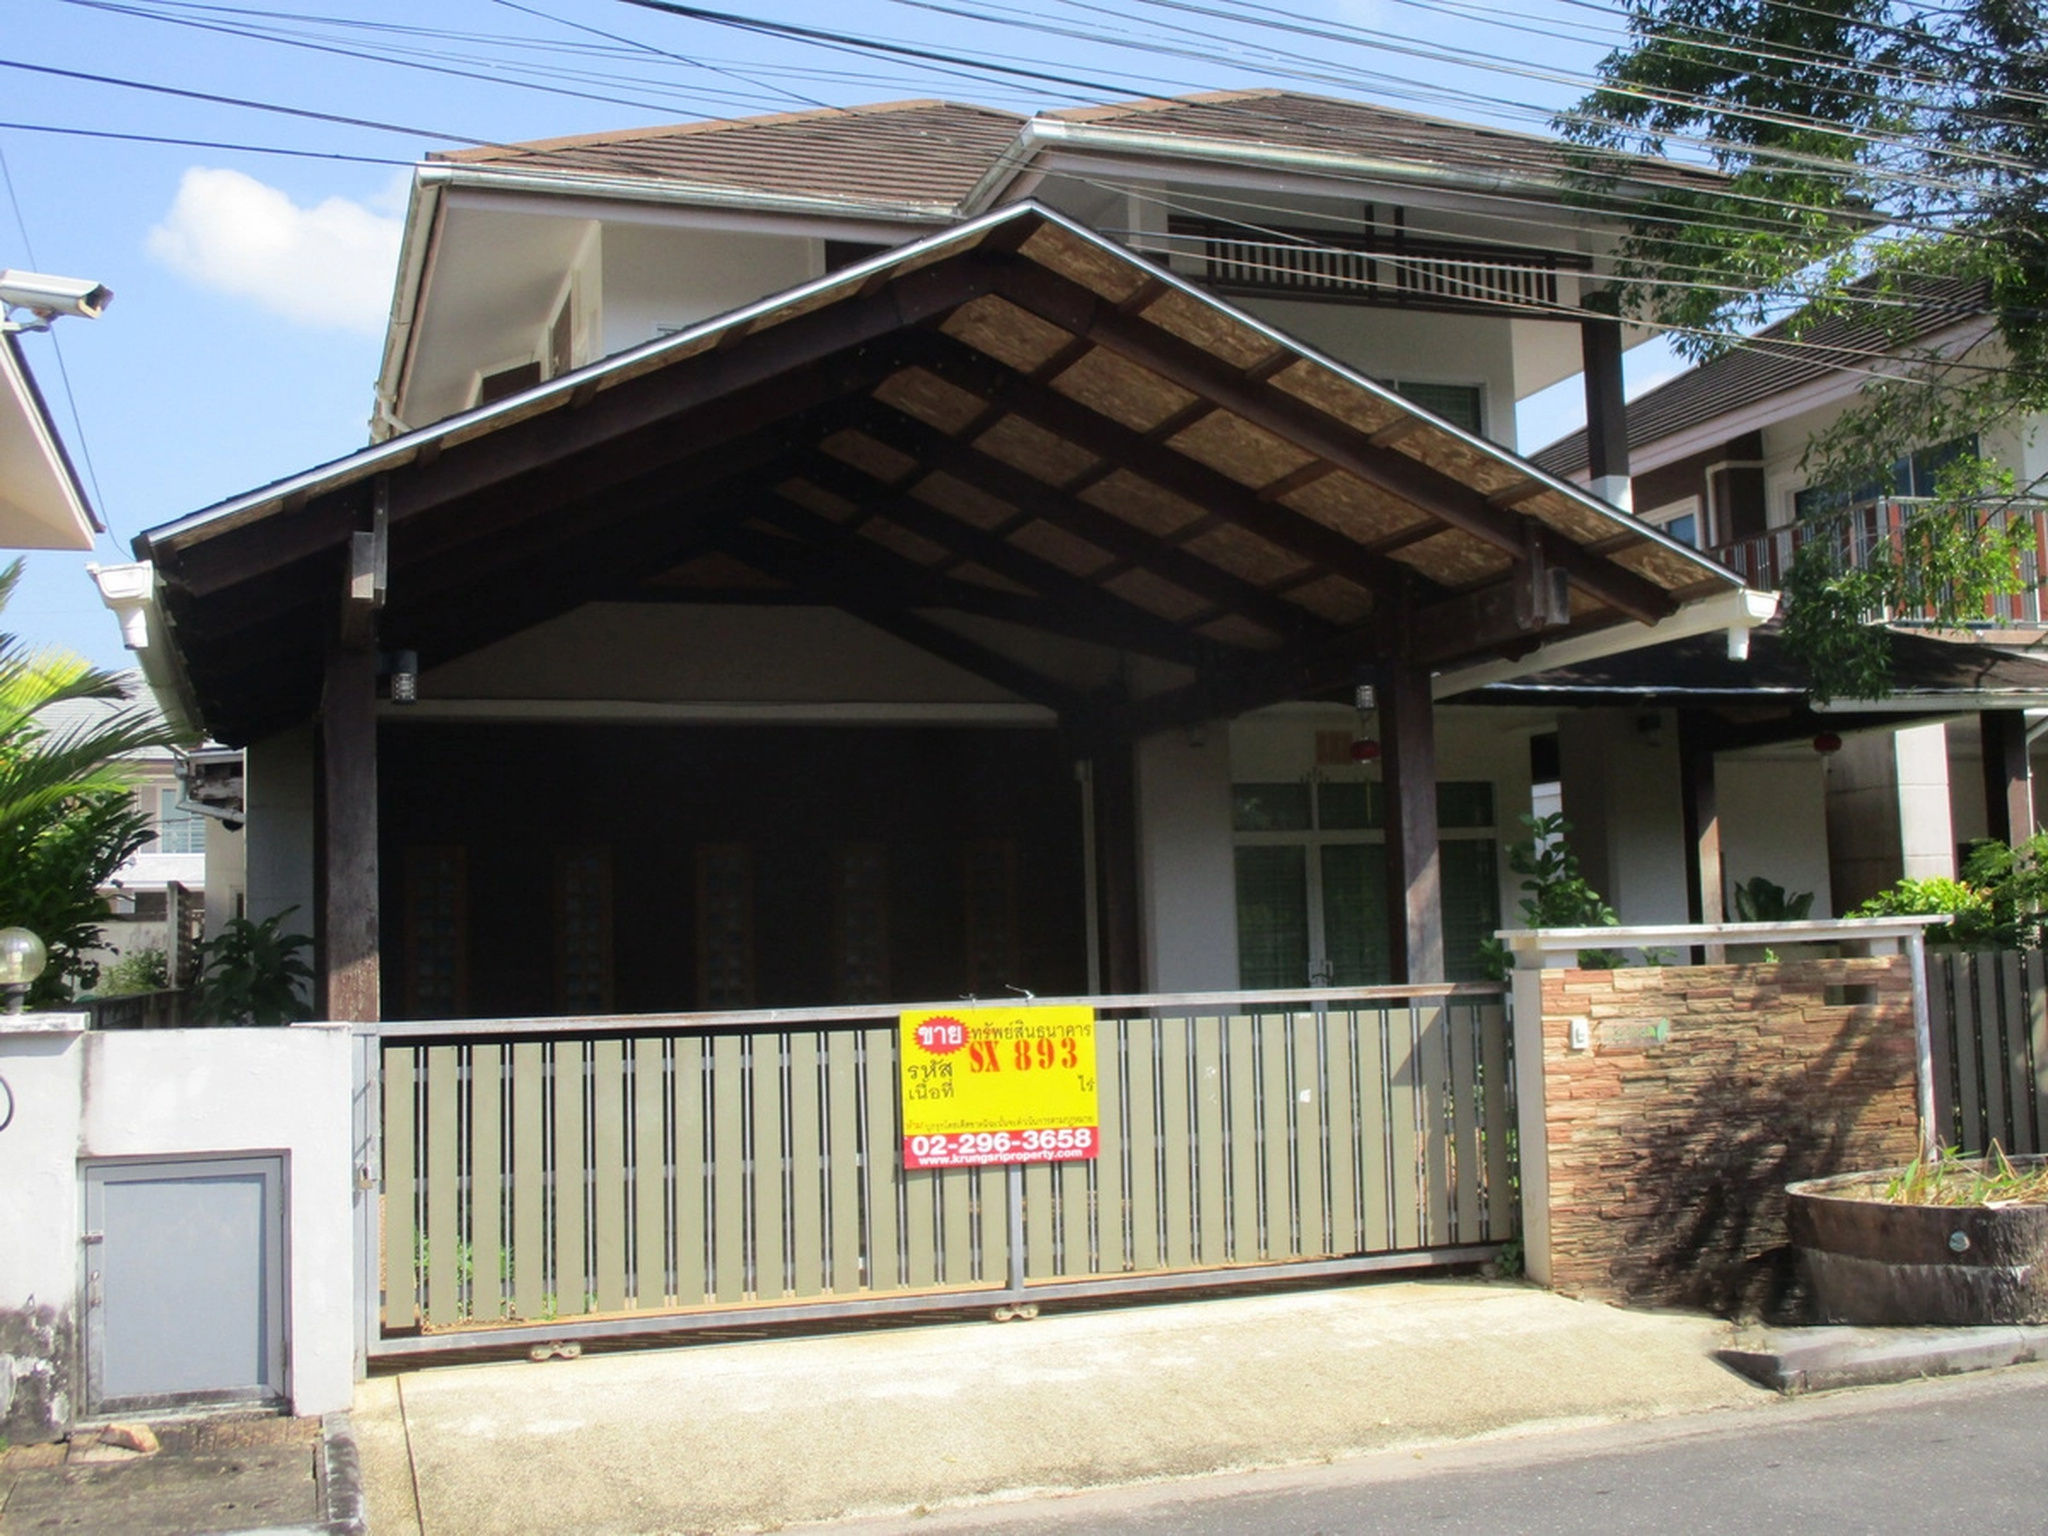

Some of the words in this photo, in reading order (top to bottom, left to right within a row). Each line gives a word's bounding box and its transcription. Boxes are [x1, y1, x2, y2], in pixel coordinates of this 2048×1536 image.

[918, 1025, 962, 1045] ขาย
[971, 1020, 1091, 1040] ทรัพย์สินธนาคาร
[969, 1040, 1000, 1073] SX
[1014, 1037, 1078, 1071] 893
[908, 1059, 953, 1080] รหัส
[909, 1078, 955, 1100] เนื้อที่
[1077, 1074, 1095, 1092] ไร่
[911, 1128, 1092, 1157] 02-296-3658
[918, 1149, 1083, 1166] www.krungsriproperty.com
